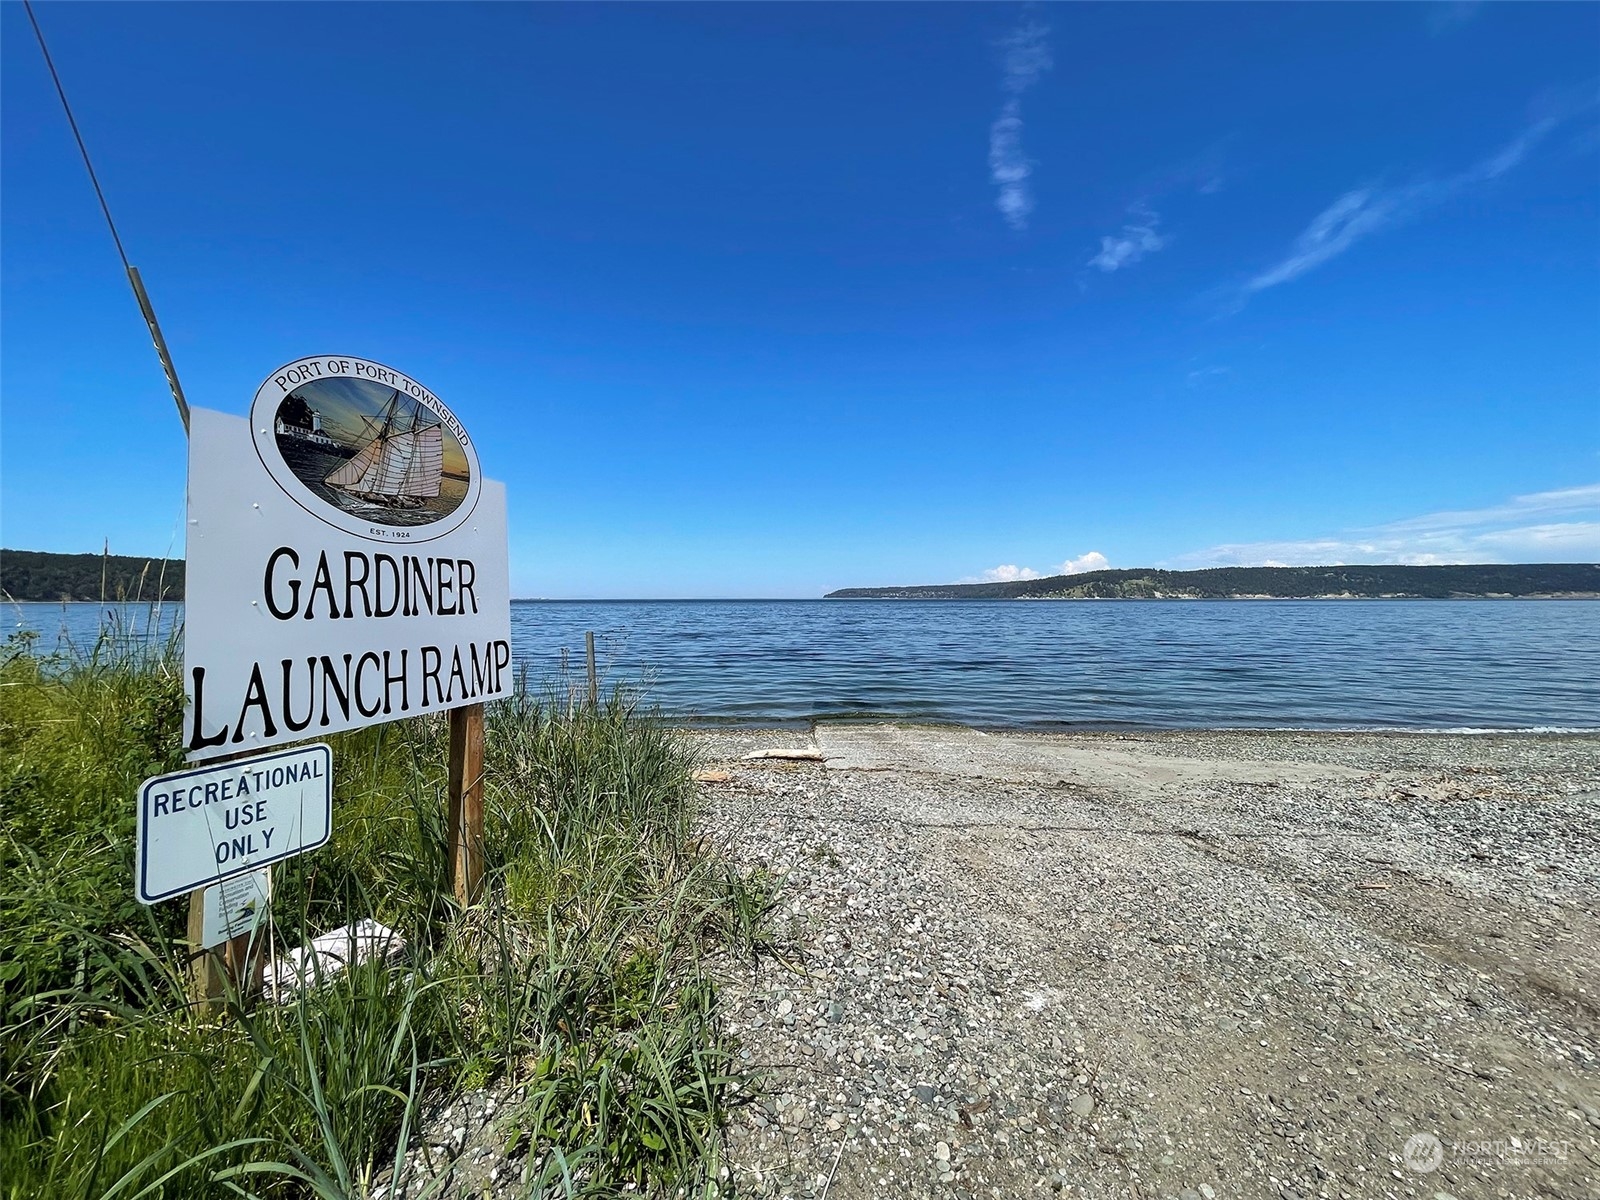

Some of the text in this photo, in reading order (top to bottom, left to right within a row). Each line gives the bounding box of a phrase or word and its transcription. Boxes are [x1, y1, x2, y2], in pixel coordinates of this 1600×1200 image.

[274, 359, 469, 447] PORT OF PORT TOWNSEND
[369, 527, 389, 537] EST.
[264, 546, 478, 620] GARDINER
[189, 640, 510, 750] LAUNCH RAMP
[153, 759, 323, 817] RECREATIONAL
[225, 800, 268, 829] USE
[216, 827, 275, 864] ONLY
